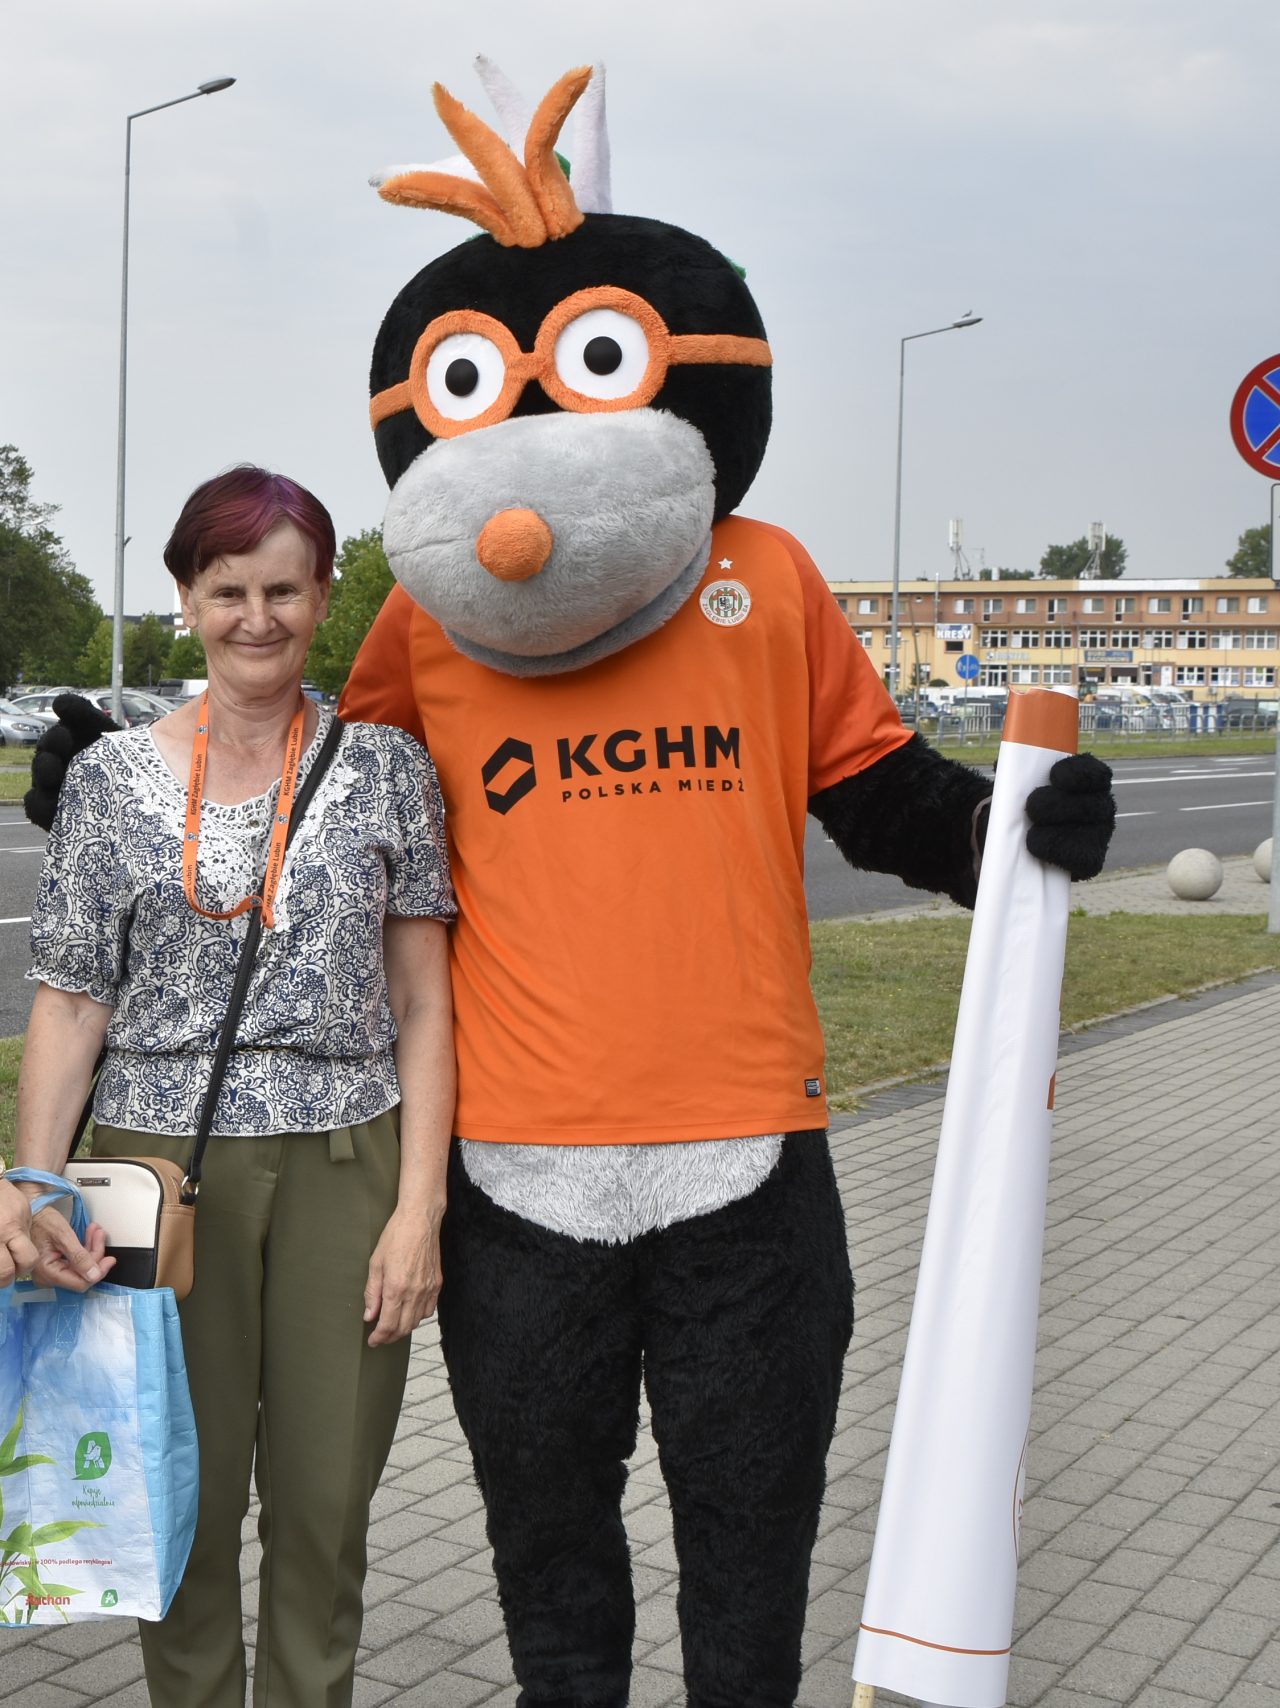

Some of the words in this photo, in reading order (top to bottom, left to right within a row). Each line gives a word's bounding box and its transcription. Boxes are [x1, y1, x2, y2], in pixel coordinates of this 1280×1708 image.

[556, 725, 740, 780] KGHM
[283, 776, 292, 796] KGHM
[562, 781, 662, 803] POLSKA
[273, 842, 281, 862] Lubin
